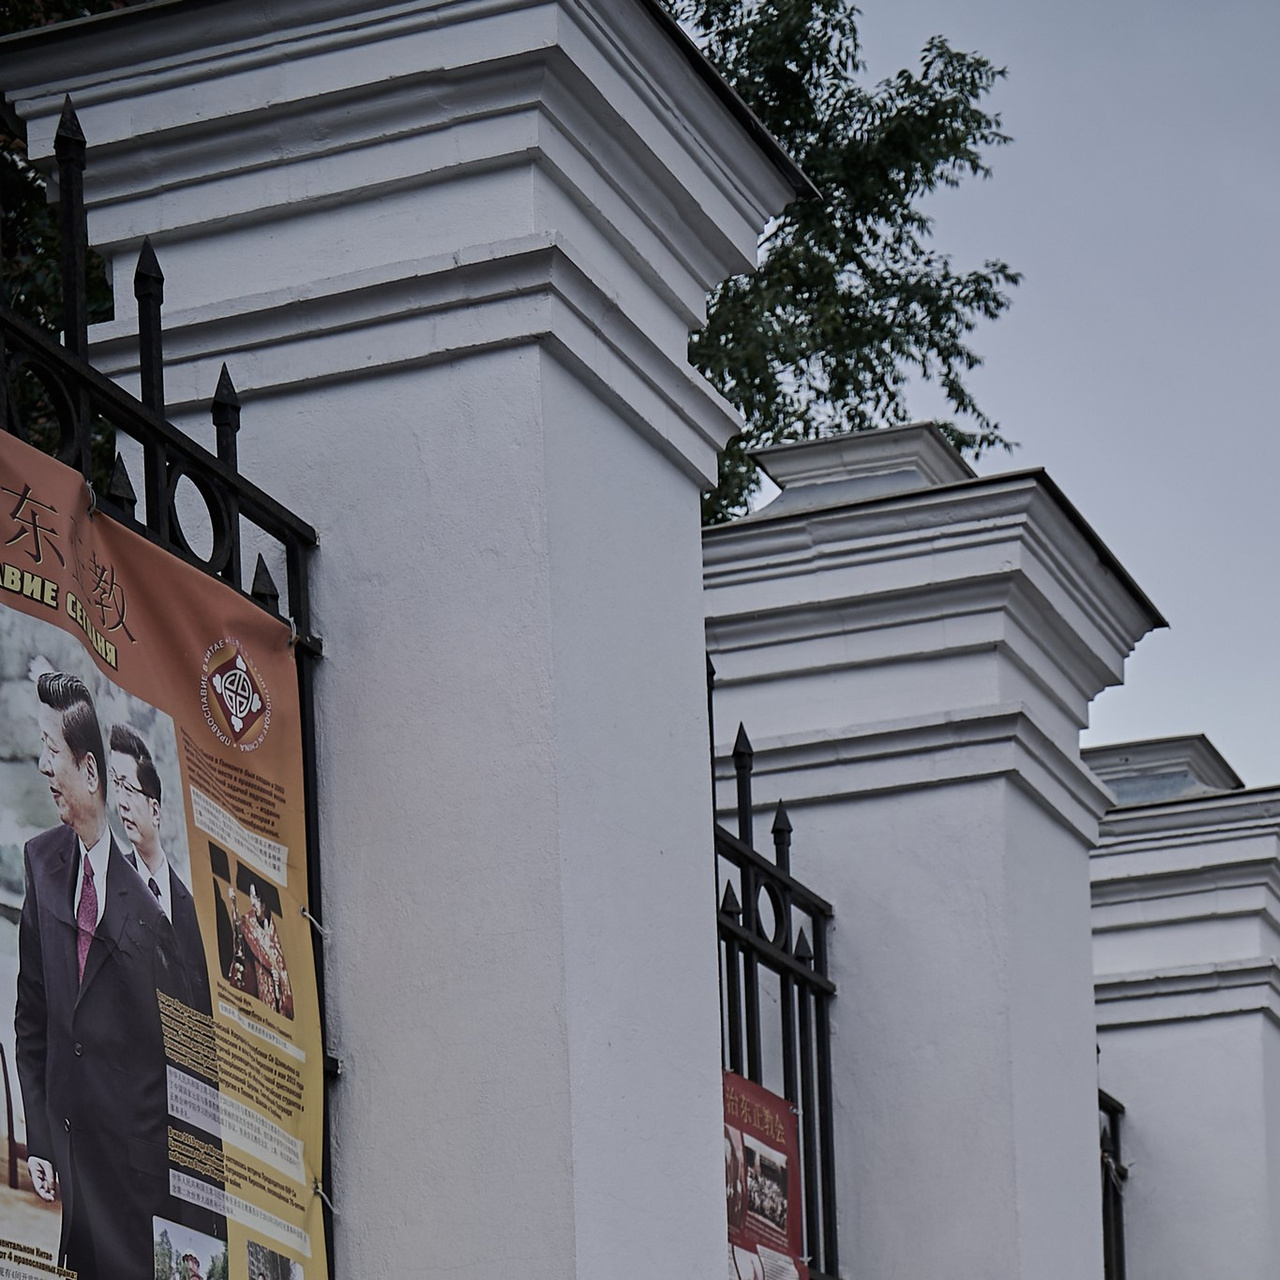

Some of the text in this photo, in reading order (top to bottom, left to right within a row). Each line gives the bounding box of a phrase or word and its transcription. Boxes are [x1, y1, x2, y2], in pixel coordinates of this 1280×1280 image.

[204, 639, 225, 664] КИТАЕ
[200, 675, 232, 747] ПРАВОСЛАВИЕ
[8, 1251, 77, 1280] 4 православных храма:
[36, 1246, 53, 1261] Китае
